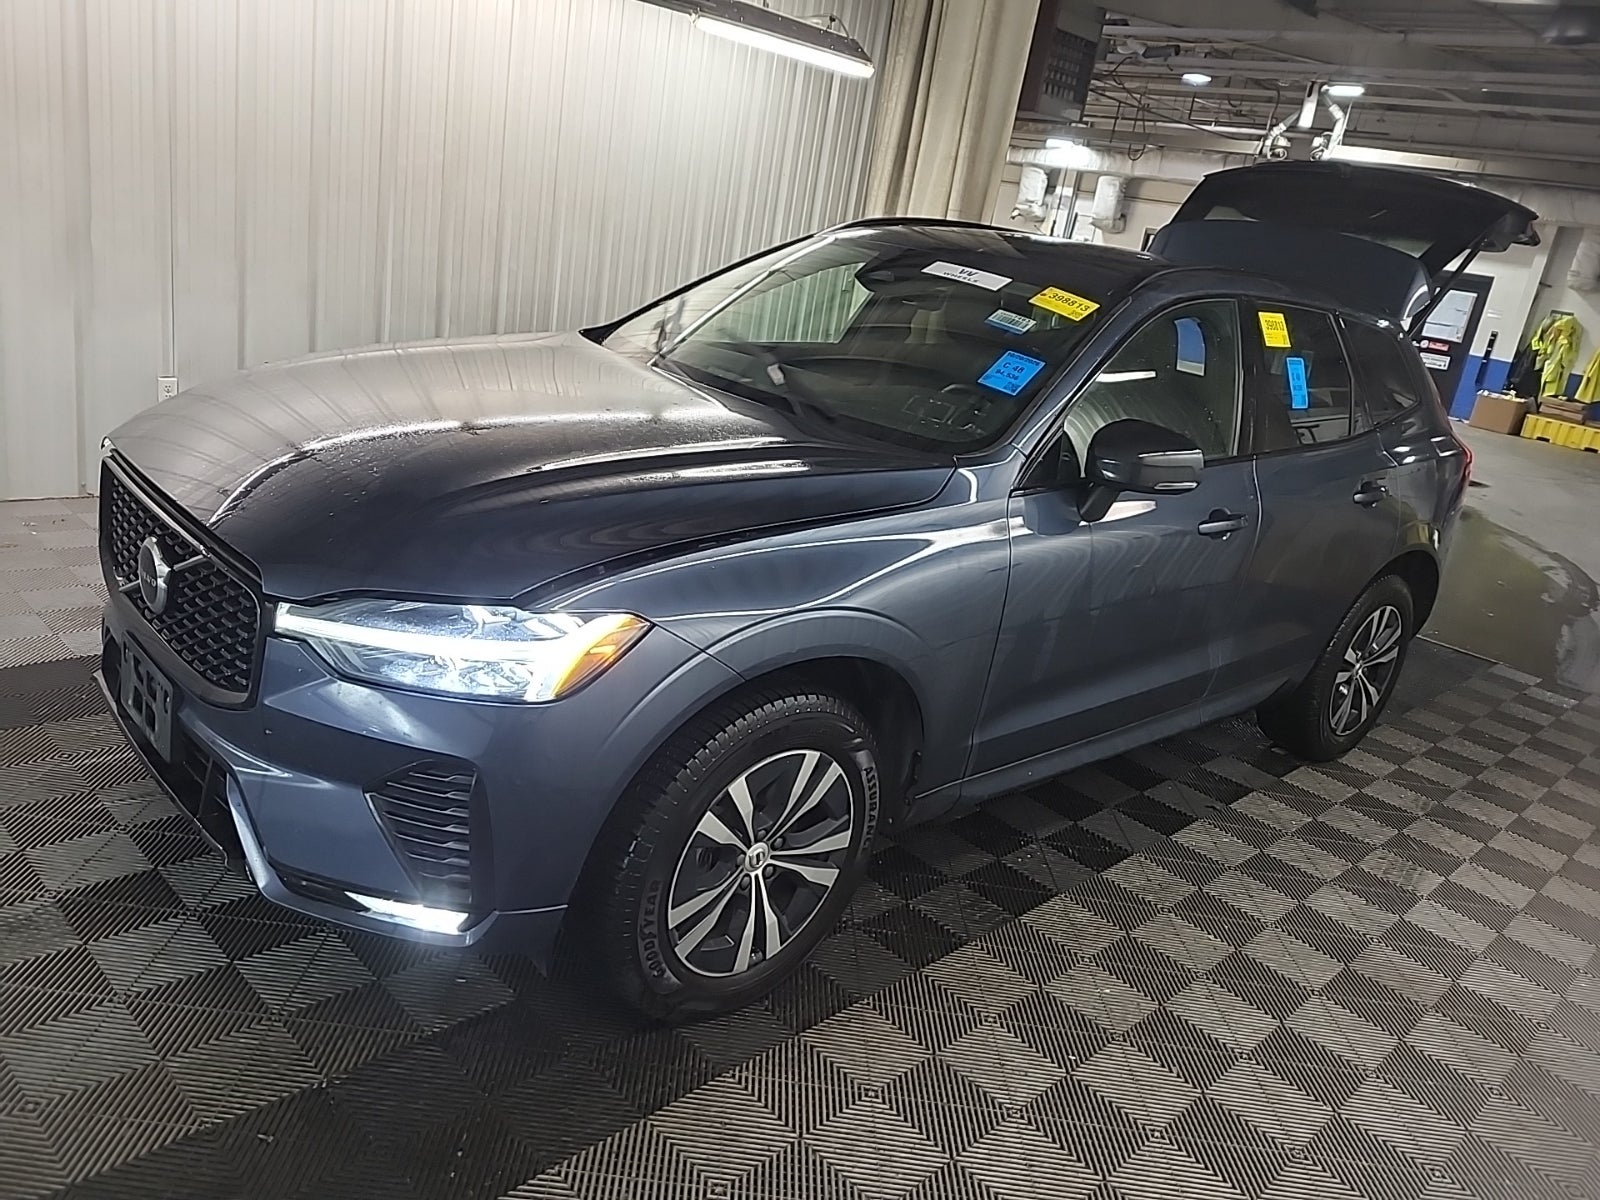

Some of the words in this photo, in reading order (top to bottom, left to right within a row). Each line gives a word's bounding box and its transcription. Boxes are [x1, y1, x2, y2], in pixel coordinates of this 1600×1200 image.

[943, 271, 979, 283] WHEELS
[1048, 292, 1090, 312] 398813
[641, 879, 666, 977] GOODYEAR
